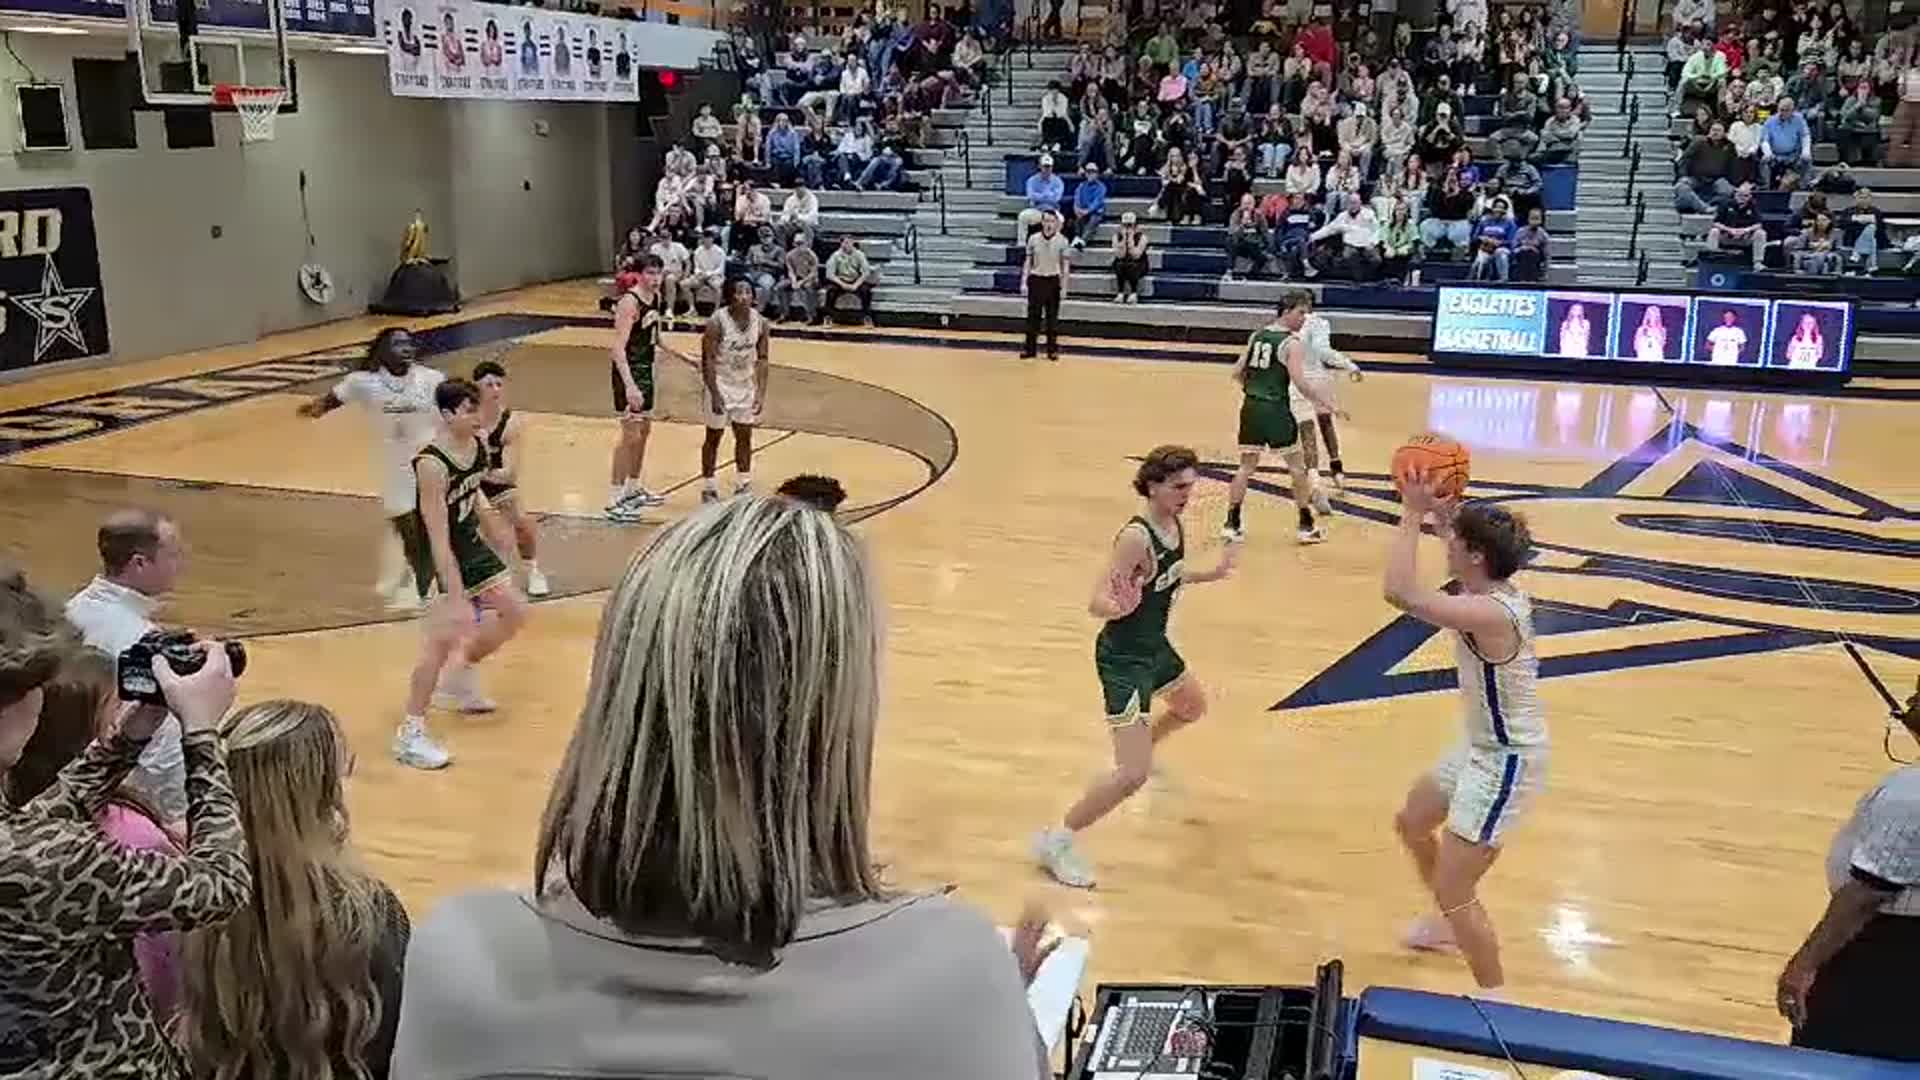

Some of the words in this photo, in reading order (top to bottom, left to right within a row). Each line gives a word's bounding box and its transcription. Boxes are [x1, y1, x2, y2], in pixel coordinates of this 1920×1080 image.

[40, 296, 71, 328] S
[1447, 293, 1537, 318] EAGLETTES
[1438, 326, 1537, 352] BASKETBALL
[1248, 341, 1273, 369] 13
